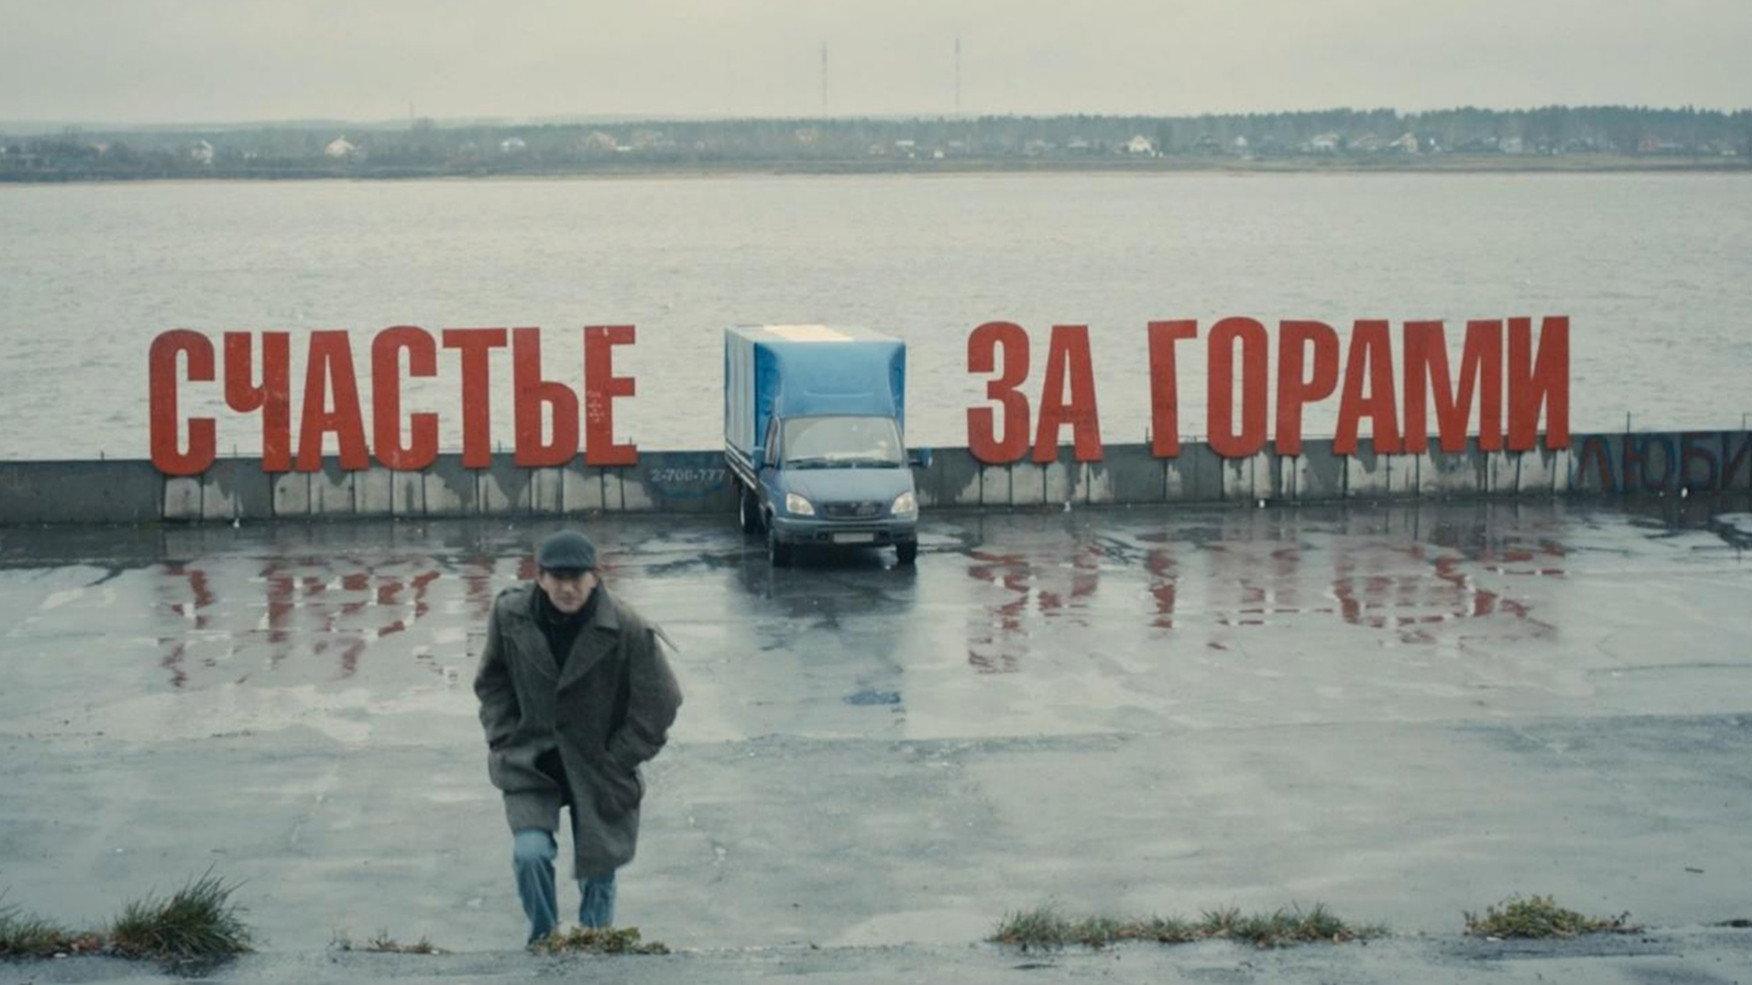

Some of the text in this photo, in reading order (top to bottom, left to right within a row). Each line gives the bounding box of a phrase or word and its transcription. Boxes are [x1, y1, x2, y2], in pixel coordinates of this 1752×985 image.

[149, 316, 1571, 476] СЧАСТЬЕ ЗА ГОРАМИ
